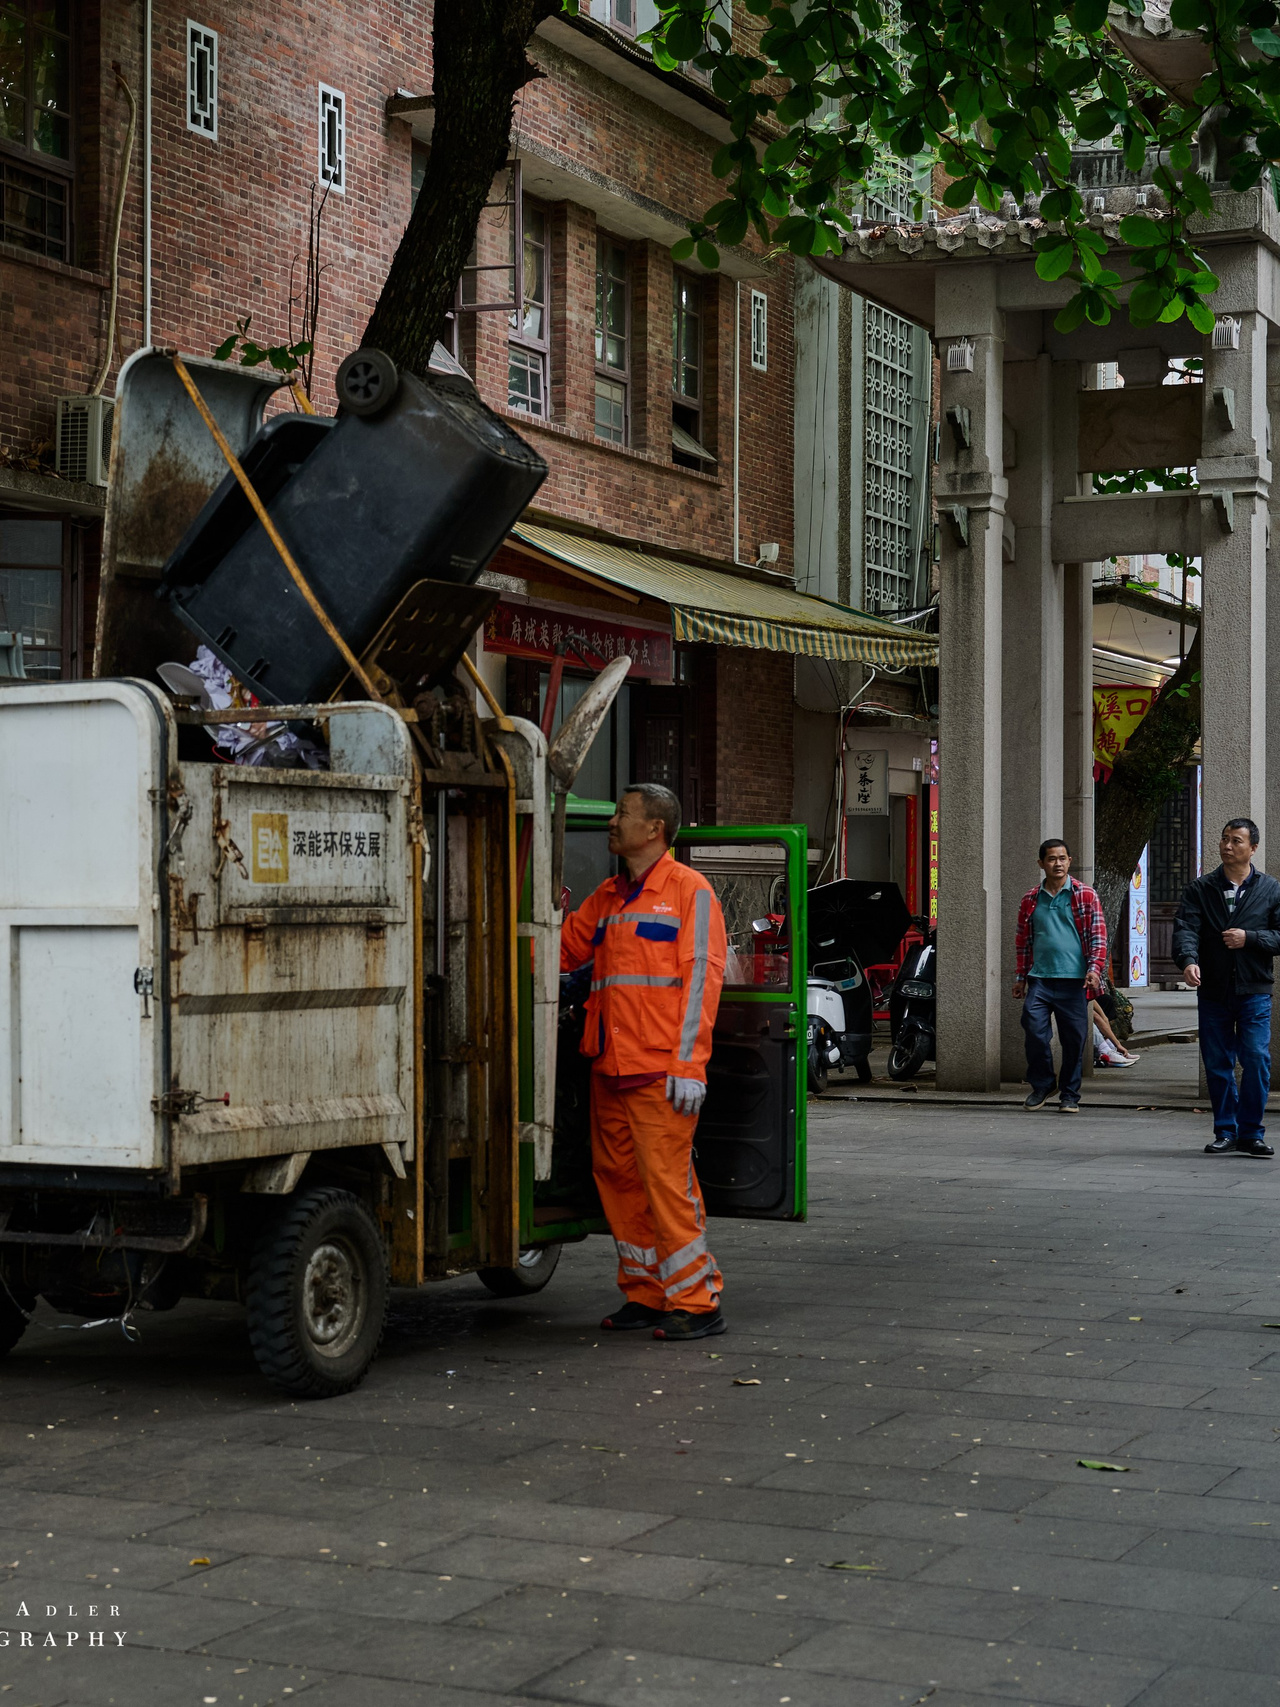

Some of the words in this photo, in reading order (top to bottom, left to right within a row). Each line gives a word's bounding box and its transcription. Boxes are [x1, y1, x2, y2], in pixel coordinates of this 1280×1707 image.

[1097, 692, 1148, 721] 溪口
[1097, 728, 1130, 756] 鹅
[292, 830, 380, 858] 深能环保发展
[930, 810, 938, 919] 溪口鹅肉
